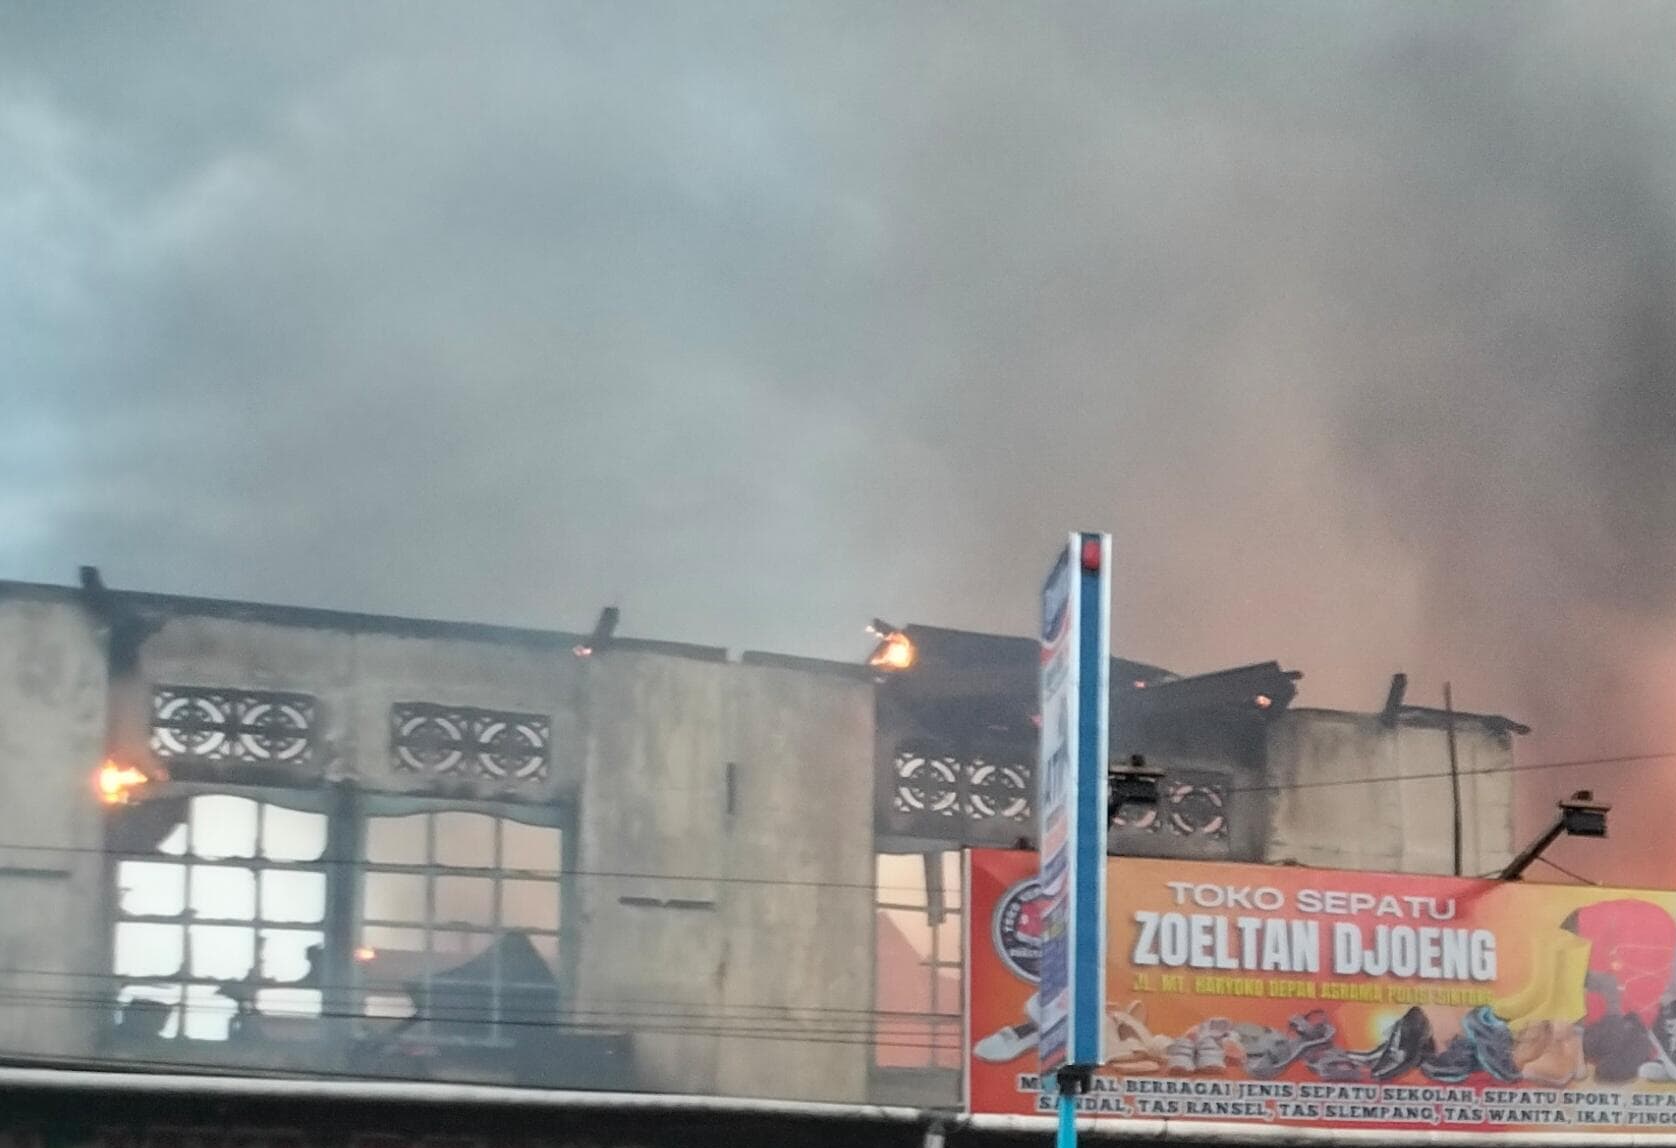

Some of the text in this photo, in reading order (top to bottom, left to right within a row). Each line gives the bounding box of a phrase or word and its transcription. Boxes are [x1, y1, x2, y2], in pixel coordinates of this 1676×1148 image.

[1166, 881, 1457, 920] TOKO SEPATU
[1133, 911, 1497, 981] ZOELTAN DJOENG
[1125, 1079, 1230, 1097] BERBAGAI
[1238, 1082, 1294, 1099] JENIS
[1299, 1084, 1377, 1101] SEPATU
[1484, 1090, 1557, 1105] SEPATU
[1138, 1099, 1178, 1114] TAS
[1279, 1103, 1320, 1118] TAS
[1444, 1107, 1483, 1121] TAS
[1577, 1110, 1622, 1124] IKAT
